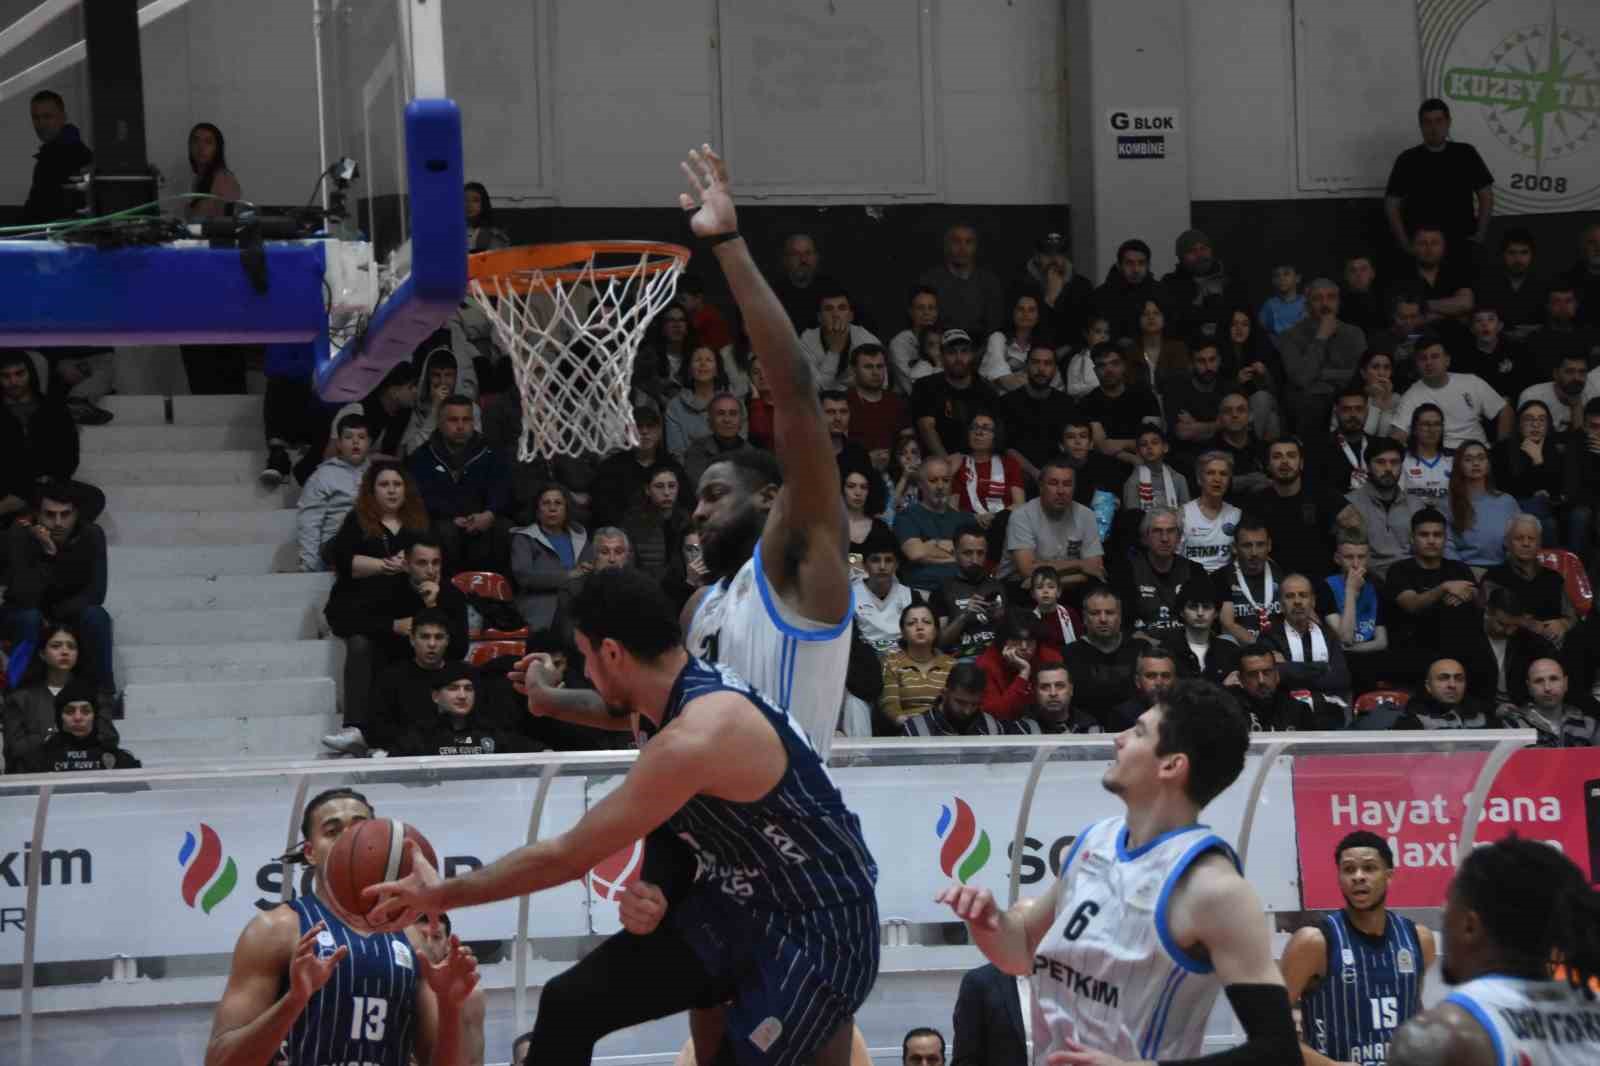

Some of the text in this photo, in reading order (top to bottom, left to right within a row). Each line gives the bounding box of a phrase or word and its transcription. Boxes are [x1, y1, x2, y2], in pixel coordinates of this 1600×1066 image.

[1451, 72, 1544, 103] KUZEY
[1110, 112, 1174, 130] G BLOK
[1510, 173, 1567, 194] 2008
[1331, 794, 1451, 833] Hayat
[1062, 900, 1100, 941] 6
[351, 996, 388, 1041] 13
[1370, 996, 1399, 1030] 15
